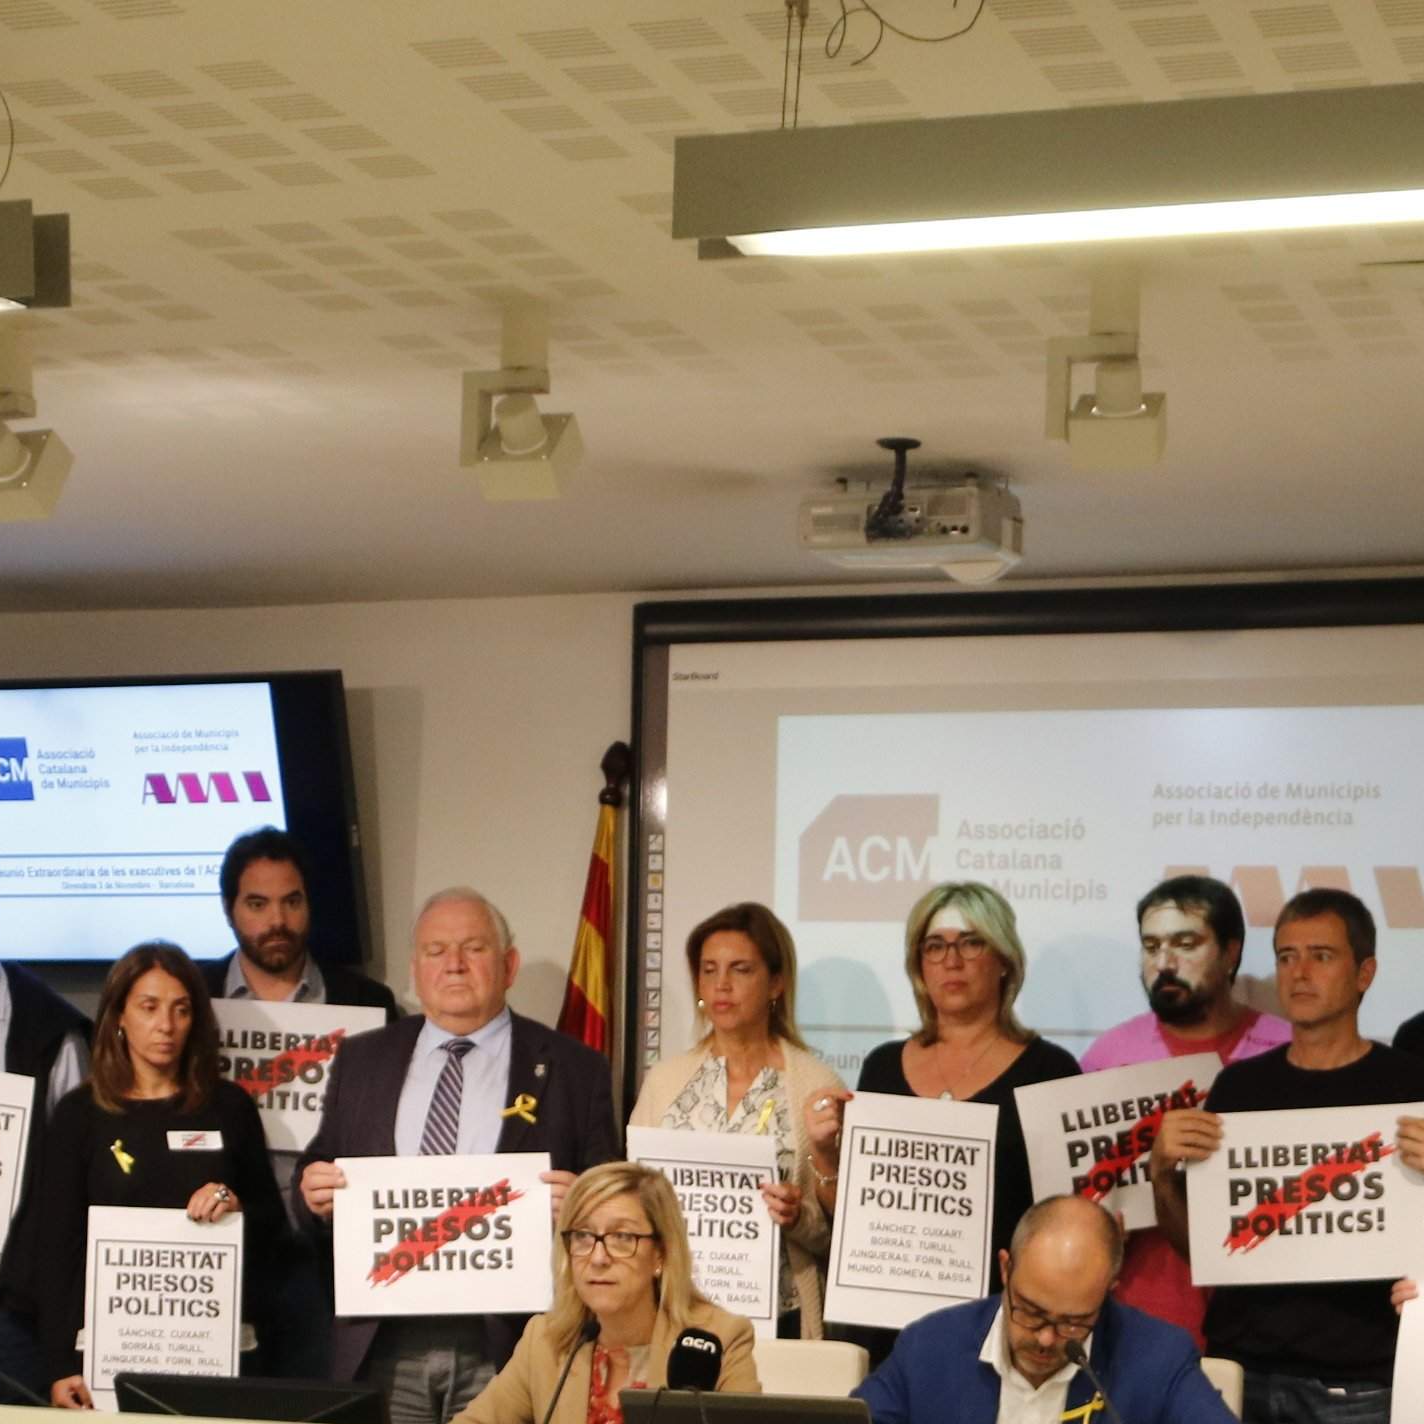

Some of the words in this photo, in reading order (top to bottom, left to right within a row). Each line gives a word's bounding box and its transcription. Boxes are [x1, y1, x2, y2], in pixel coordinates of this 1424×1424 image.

[37, 749, 96, 759] Associació
[39, 764, 87, 774] Catalana
[41, 778, 54, 789] de
[58, 778, 111, 790] Municipis
[1152, 782, 1251, 800] Associació
[1256, 783, 1280, 799] de
[1286, 782, 1381, 802] Municipis
[956, 818, 1086, 841] Associació
[1152, 811, 1182, 830] per
[1188, 809, 1204, 826] la
[1210, 808, 1354, 829] Independència
[822, 835, 940, 882] ACM
[955, 849, 1062, 871] Catalana
[859, 1136, 980, 1166] LLIBERTAT
[1066, 1126, 1154, 1168] PRES
[1228, 1140, 1384, 1170] LLIBERTAT
[870, 1162, 968, 1191] PRESOS
[372, 1187, 512, 1209] LLIBERTAT
[1229, 1171, 1385, 1206] PRESOS
[860, 1187, 974, 1218] POLÍTICS
[373, 1215, 513, 1243] PRESOS
[105, 1248, 227, 1270] LLIBERTAT
[116, 1273, 215, 1294] PRESOS
[108, 1293, 221, 1318] POLÍTICS
[681, 1336, 716, 1354] acn
